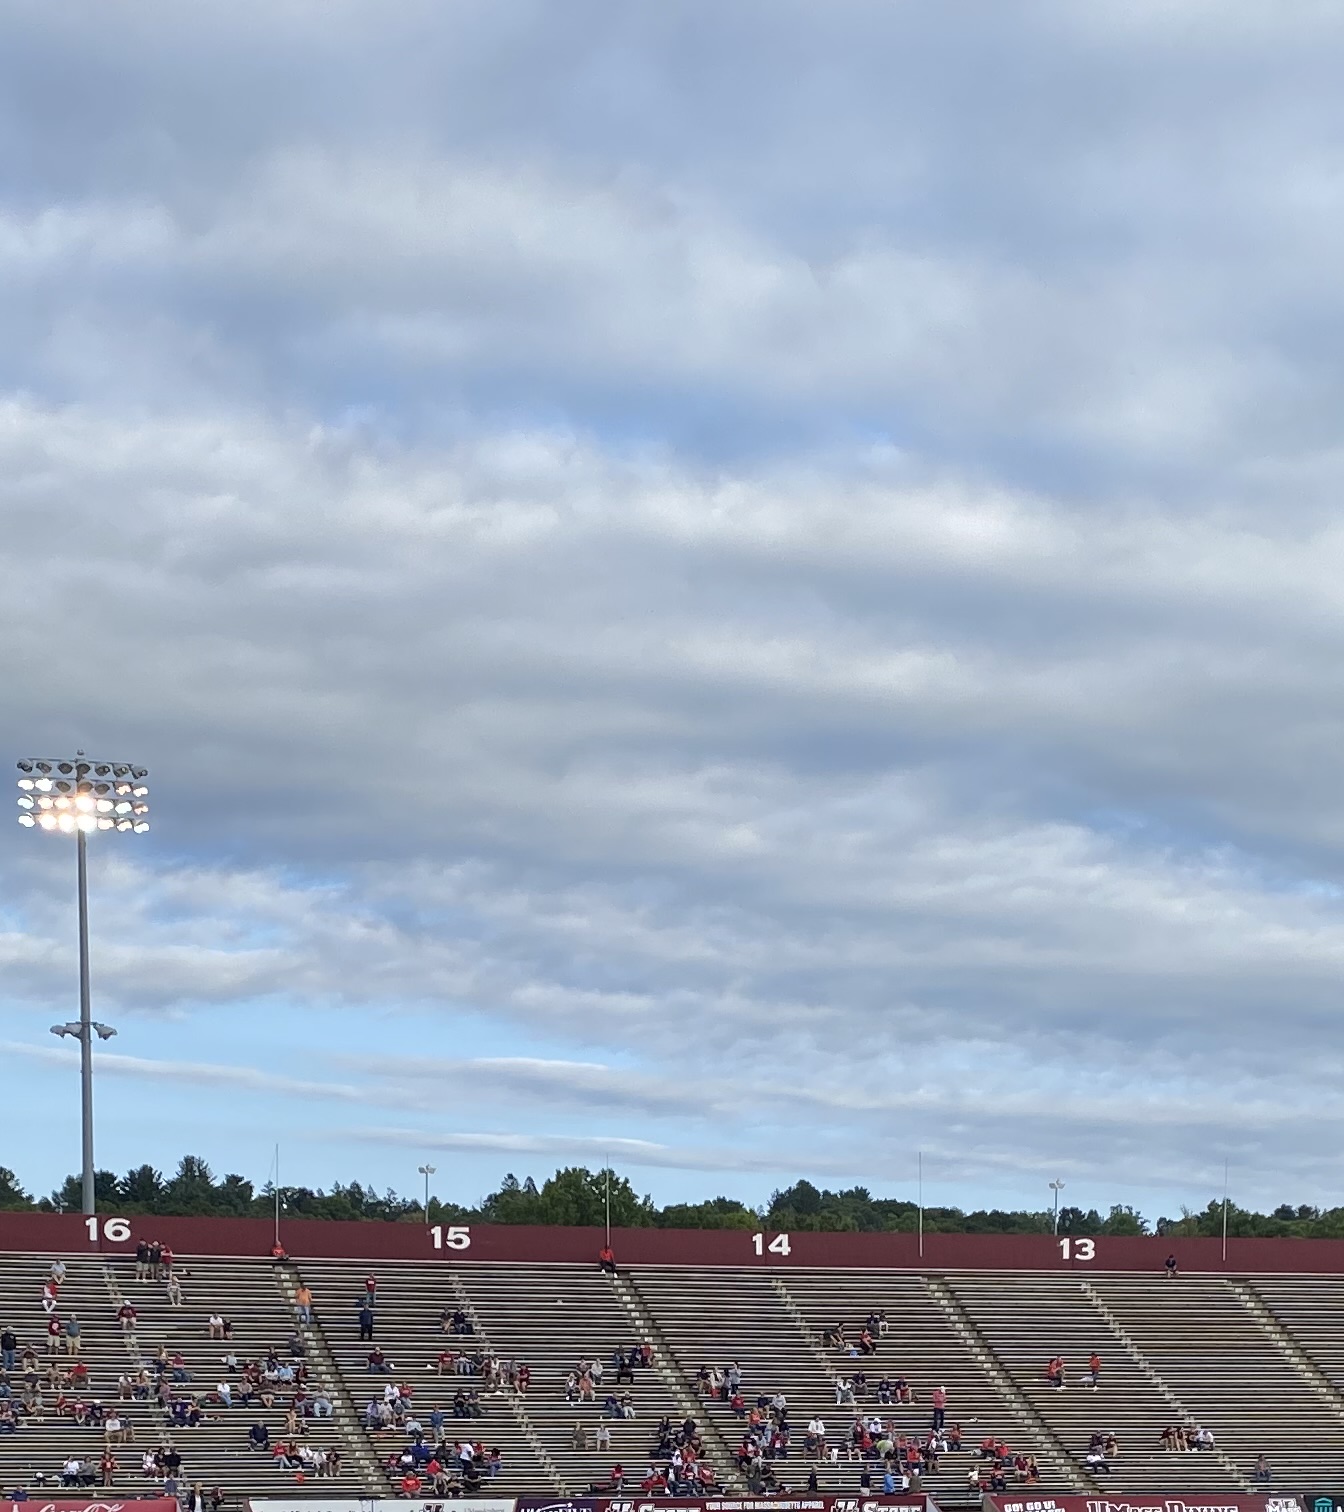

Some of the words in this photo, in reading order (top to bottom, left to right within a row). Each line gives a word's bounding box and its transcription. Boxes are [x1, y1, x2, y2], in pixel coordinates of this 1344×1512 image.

[85, 1217, 131, 1243] 16
[430, 1225, 471, 1250] 15
[751, 1233, 792, 1257] 14
[1059, 1238, 1096, 1261] 13
[1004, 1503, 1023, 1512] GO!
[1026, 1501, 1042, 1512] GO
[1043, 1500, 1056, 1510] U!
